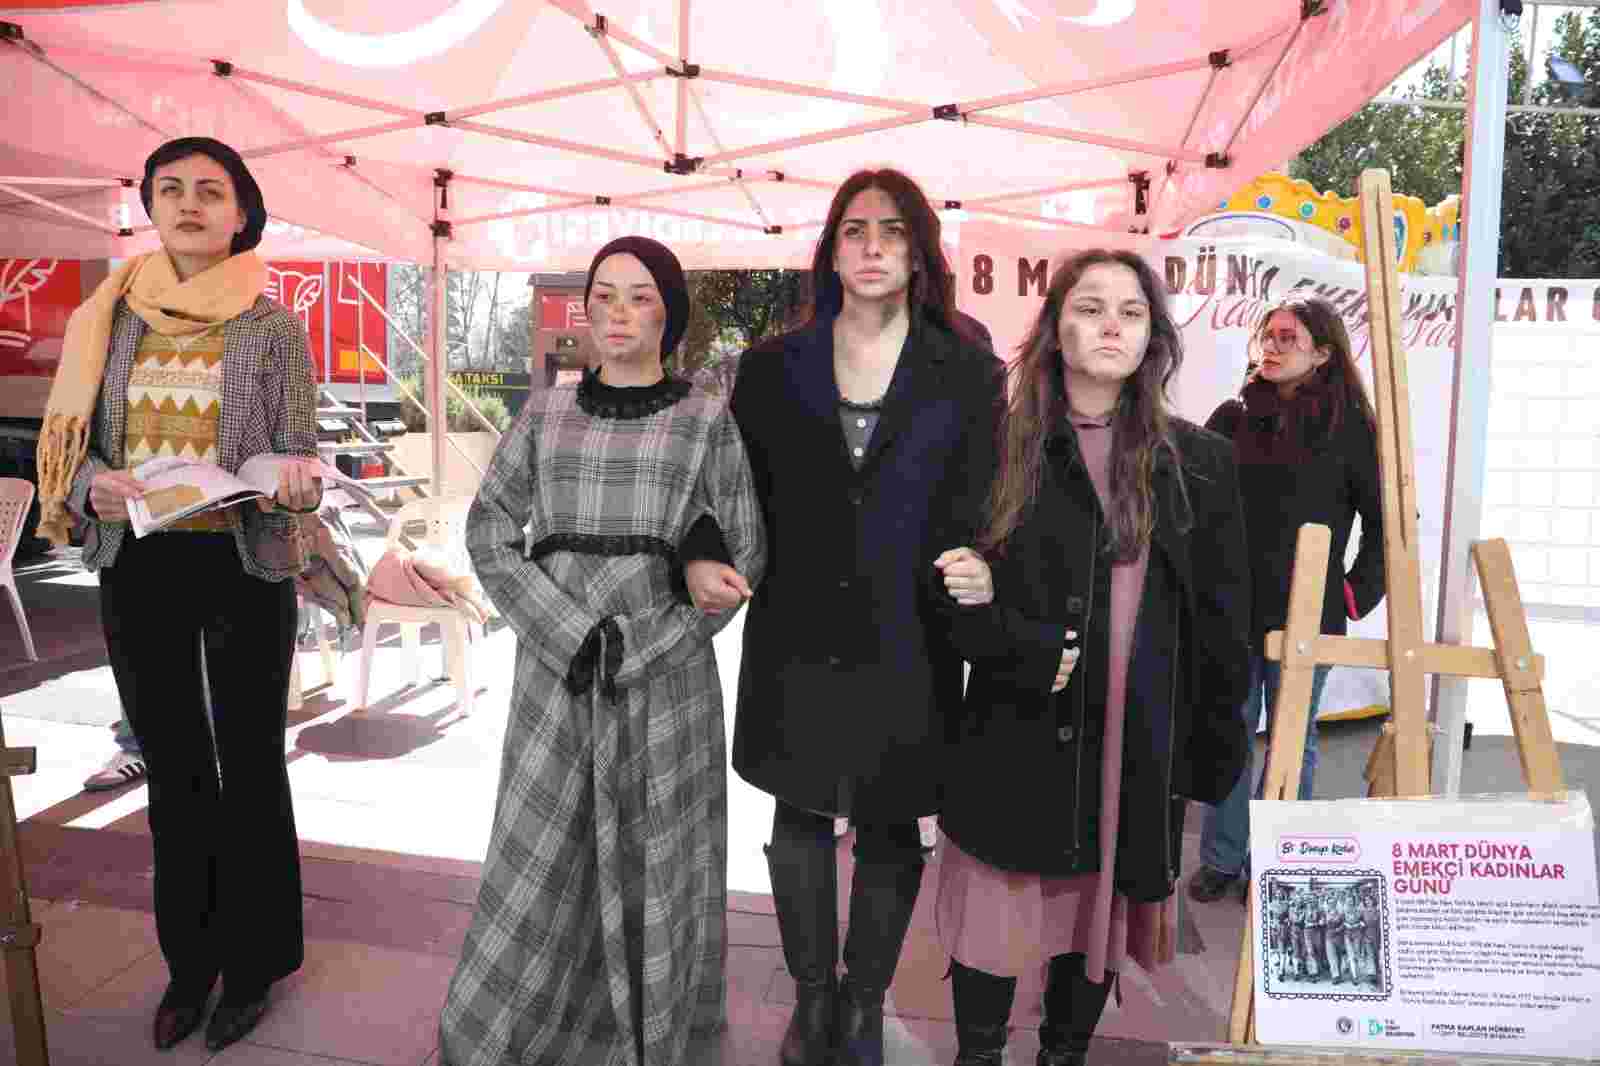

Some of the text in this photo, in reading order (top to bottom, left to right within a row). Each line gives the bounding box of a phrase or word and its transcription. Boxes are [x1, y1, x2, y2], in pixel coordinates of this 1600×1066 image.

[973, 254, 993, 295] 8
[1164, 246, 1280, 302] DÜNYA
[1392, 839, 1533, 861] 8 MART DÜNYA
[1392, 858, 1566, 880] EMEKÇİ KADINLAR
